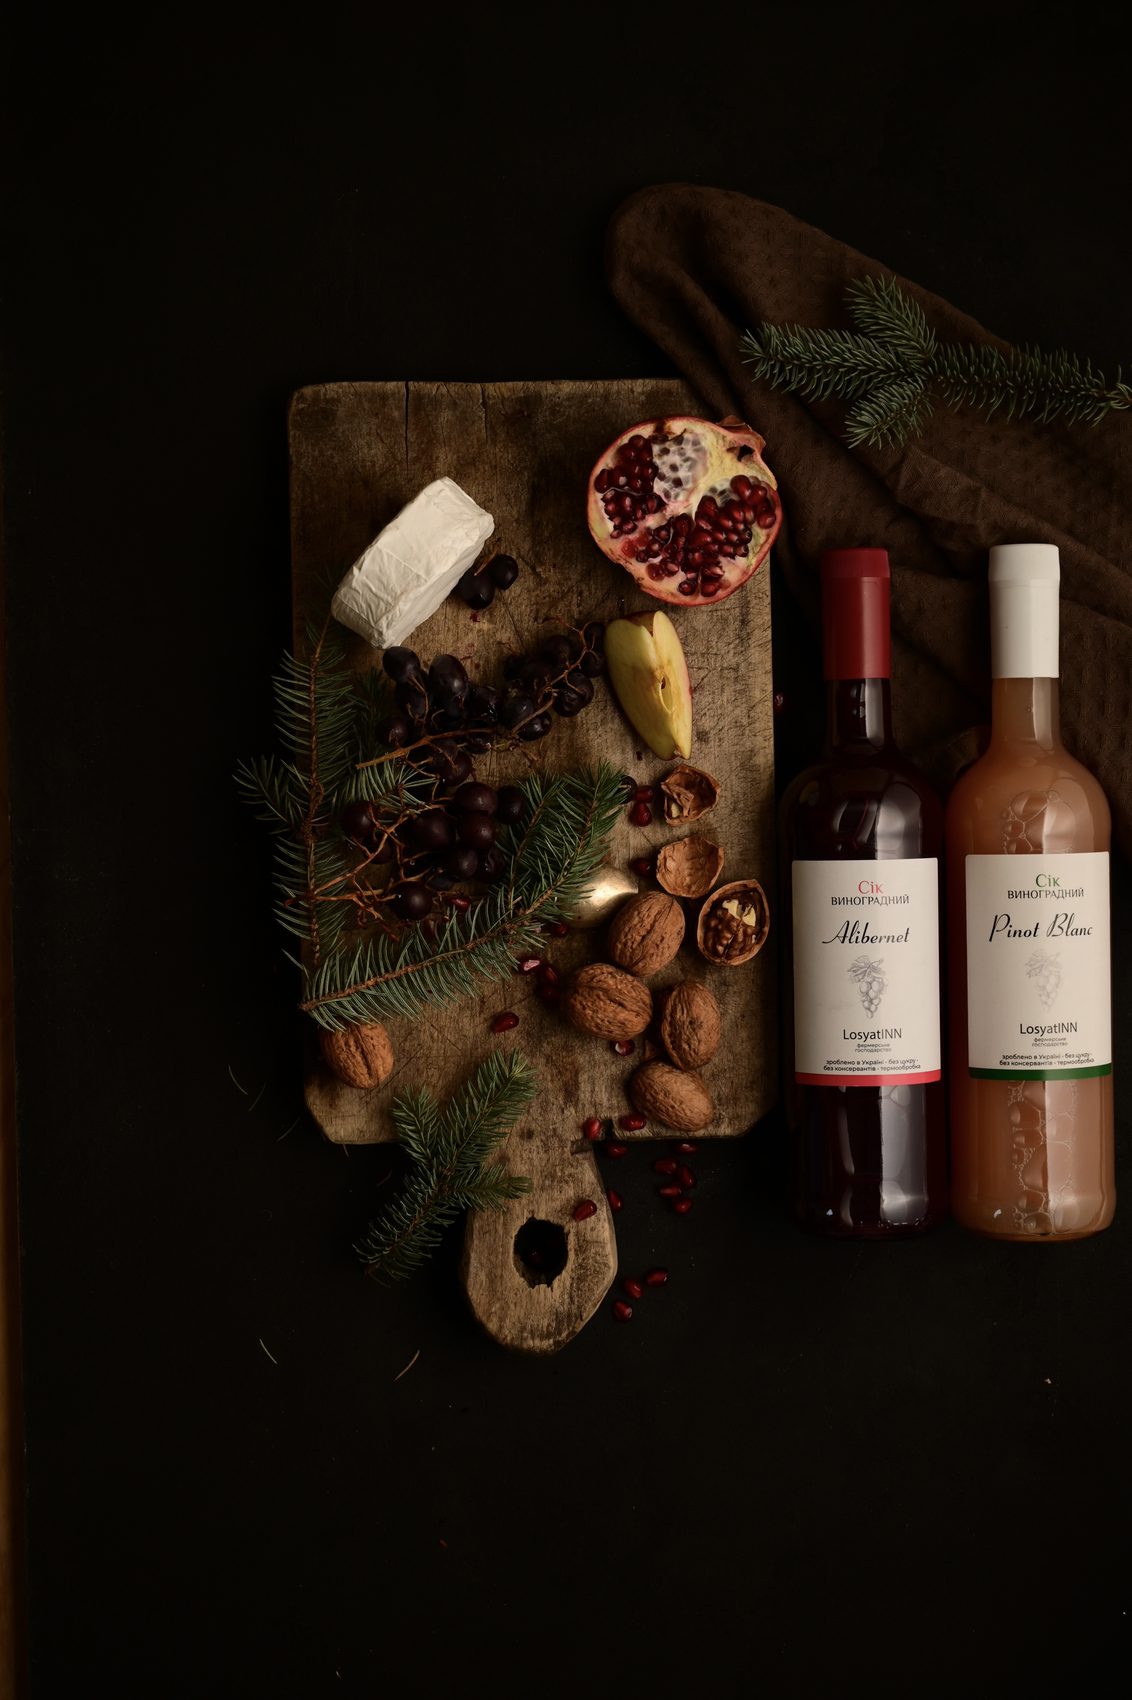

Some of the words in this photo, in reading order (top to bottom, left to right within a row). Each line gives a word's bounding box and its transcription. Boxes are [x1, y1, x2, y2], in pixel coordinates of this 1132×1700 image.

[858, 880, 884, 895] Сік
[1035, 873, 1061, 888] Сік
[831, 894, 910, 906] ВИНОГРАДНИЙ
[1007, 887, 1085, 899] ВИНОГРАДНИЙ
[822, 920, 910, 944] Alibernet
[989, 913, 1040, 943] Pinot
[1046, 912, 1094, 938] Blanc
[843, 1028, 902, 1042] LosyatINN
[1020, 1022, 1078, 1037] LosyatINN
